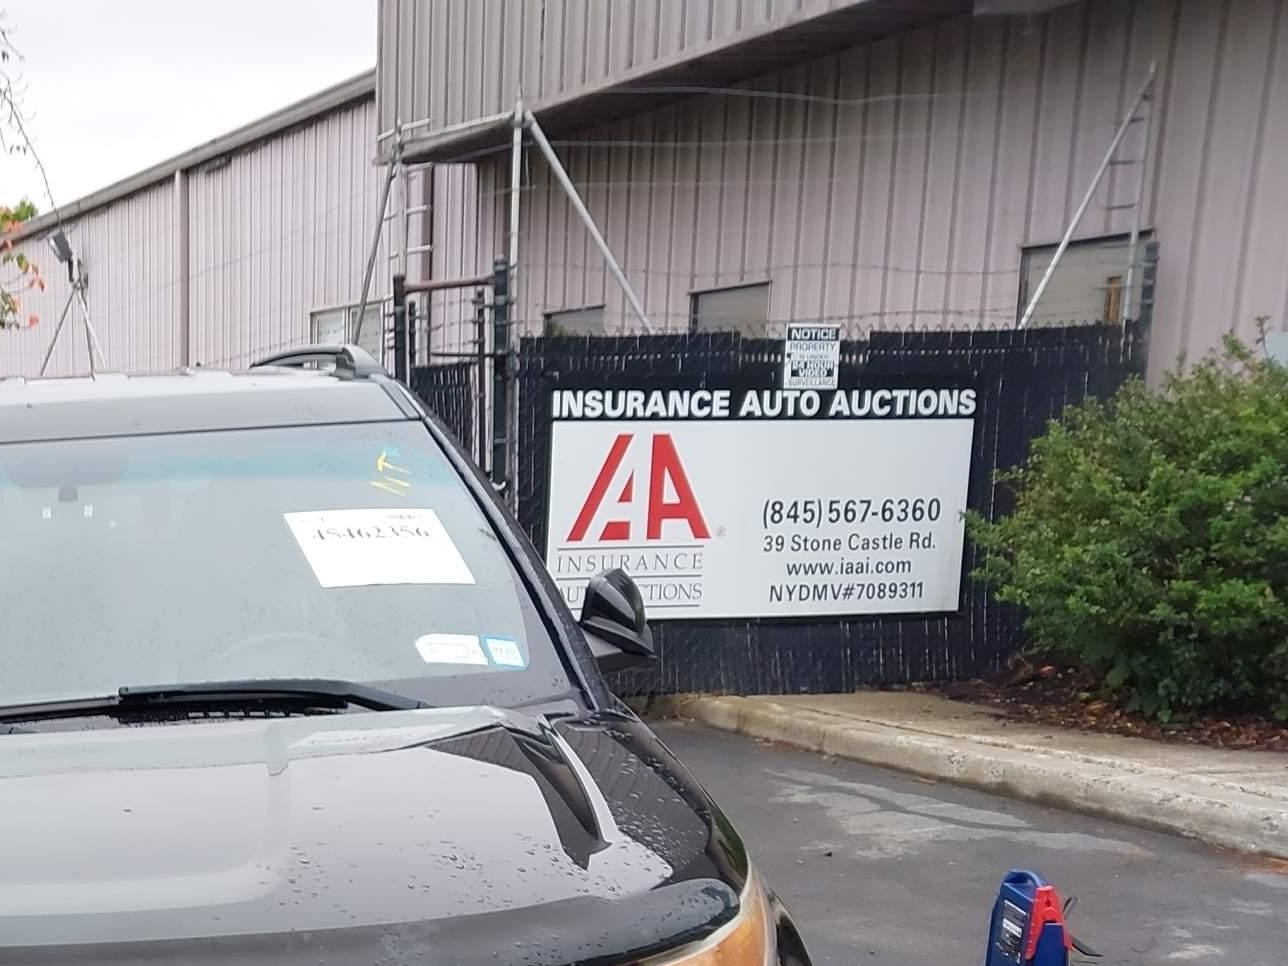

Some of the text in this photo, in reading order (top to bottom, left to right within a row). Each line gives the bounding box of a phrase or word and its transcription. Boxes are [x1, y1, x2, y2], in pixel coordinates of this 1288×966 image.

[791, 327, 836, 340] NOTICE
[790, 342, 836, 351] PROPERTY
[798, 368, 828, 377] VIDEO
[806, 360, 834, 370] HOUR
[789, 377, 835, 387] SURVEILLANCE
[552, 388, 977, 418] INSURANCE AUTO AUCTIONS
[763, 531, 936, 552] 39 Stone Castle Rd.
[556, 553, 704, 573] INSURANCE
[786, 556, 912, 576] www.iaai.com
[769, 582, 924, 602] NYDMV#7089311
